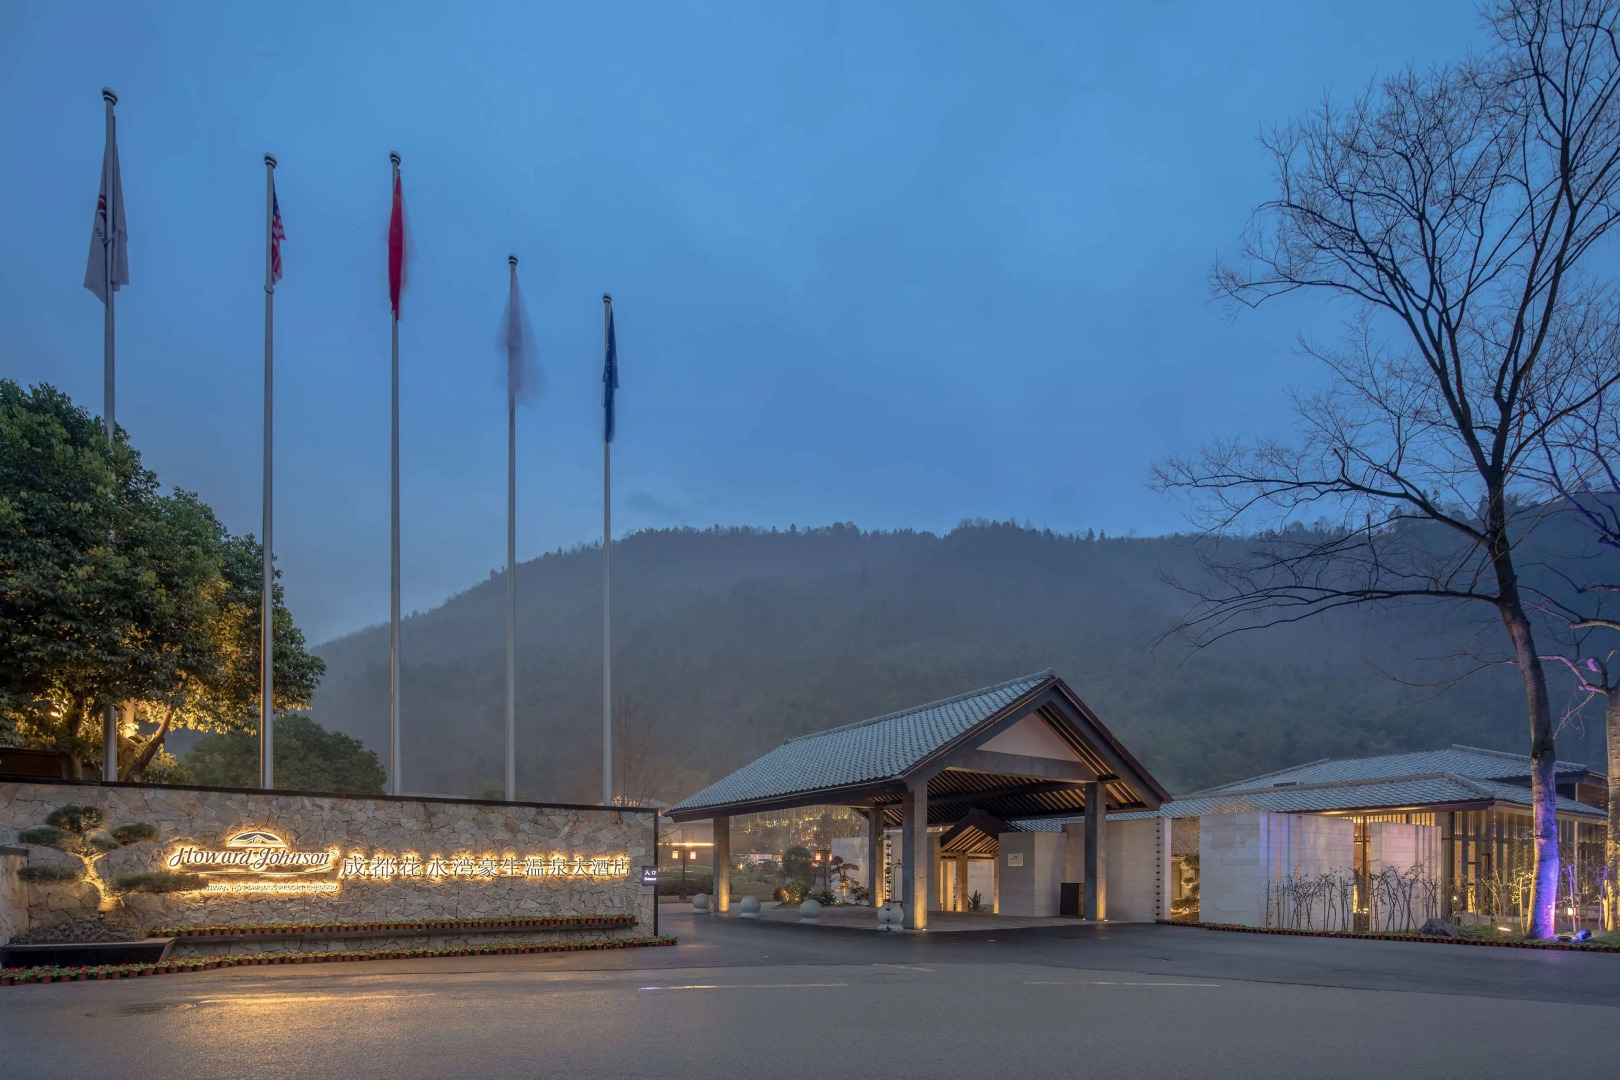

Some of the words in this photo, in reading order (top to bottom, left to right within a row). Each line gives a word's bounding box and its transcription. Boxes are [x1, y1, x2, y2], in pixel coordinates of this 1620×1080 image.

[169, 847, 251, 867] Howard
[253, 847, 331, 870] Johnson
[340, 855, 629, 878] 成都花水湾豪生温泉大酒店
[231, 884, 247, 892] HOT
